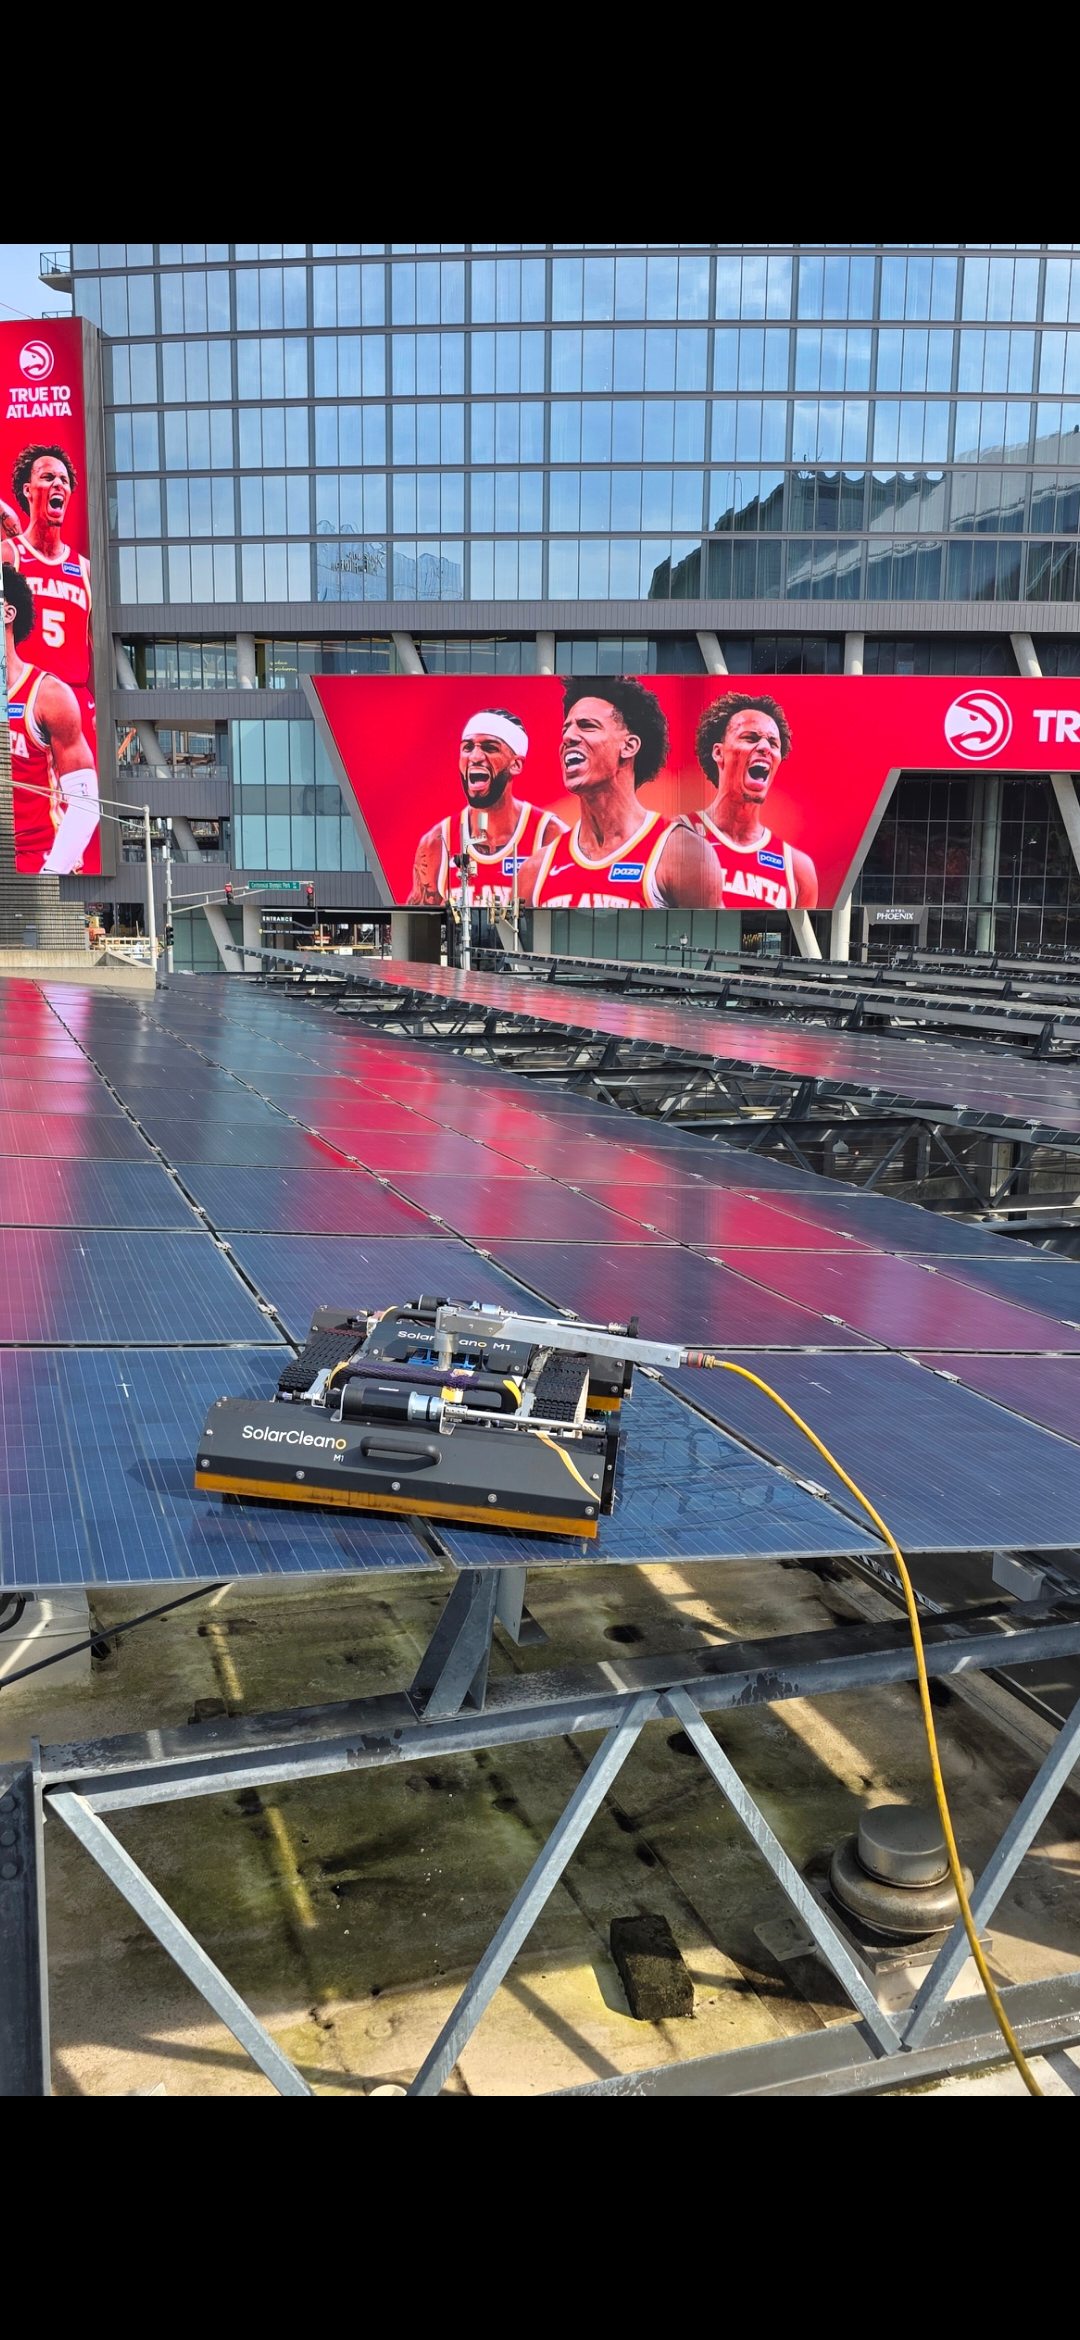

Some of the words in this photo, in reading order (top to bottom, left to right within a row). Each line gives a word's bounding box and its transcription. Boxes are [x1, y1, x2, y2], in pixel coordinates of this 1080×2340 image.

[9, 386, 49, 402] TRUE
[50, 385, 71, 401] TO
[6, 401, 73, 419] ATLANTA
[26, 576, 87, 611] TLANTA
[42, 608, 65, 648] 5
[760, 854, 783, 866] paze
[612, 867, 641, 876] paze
[721, 867, 787, 909] LANTA
[876, 912, 914, 920] PHOENIX
[397, 1330, 487, 1348] Solarano
[492, 1342, 511, 1352] M1
[242, 1425, 347, 1450] SolarCleano
[333, 1454, 344, 1462] M1
